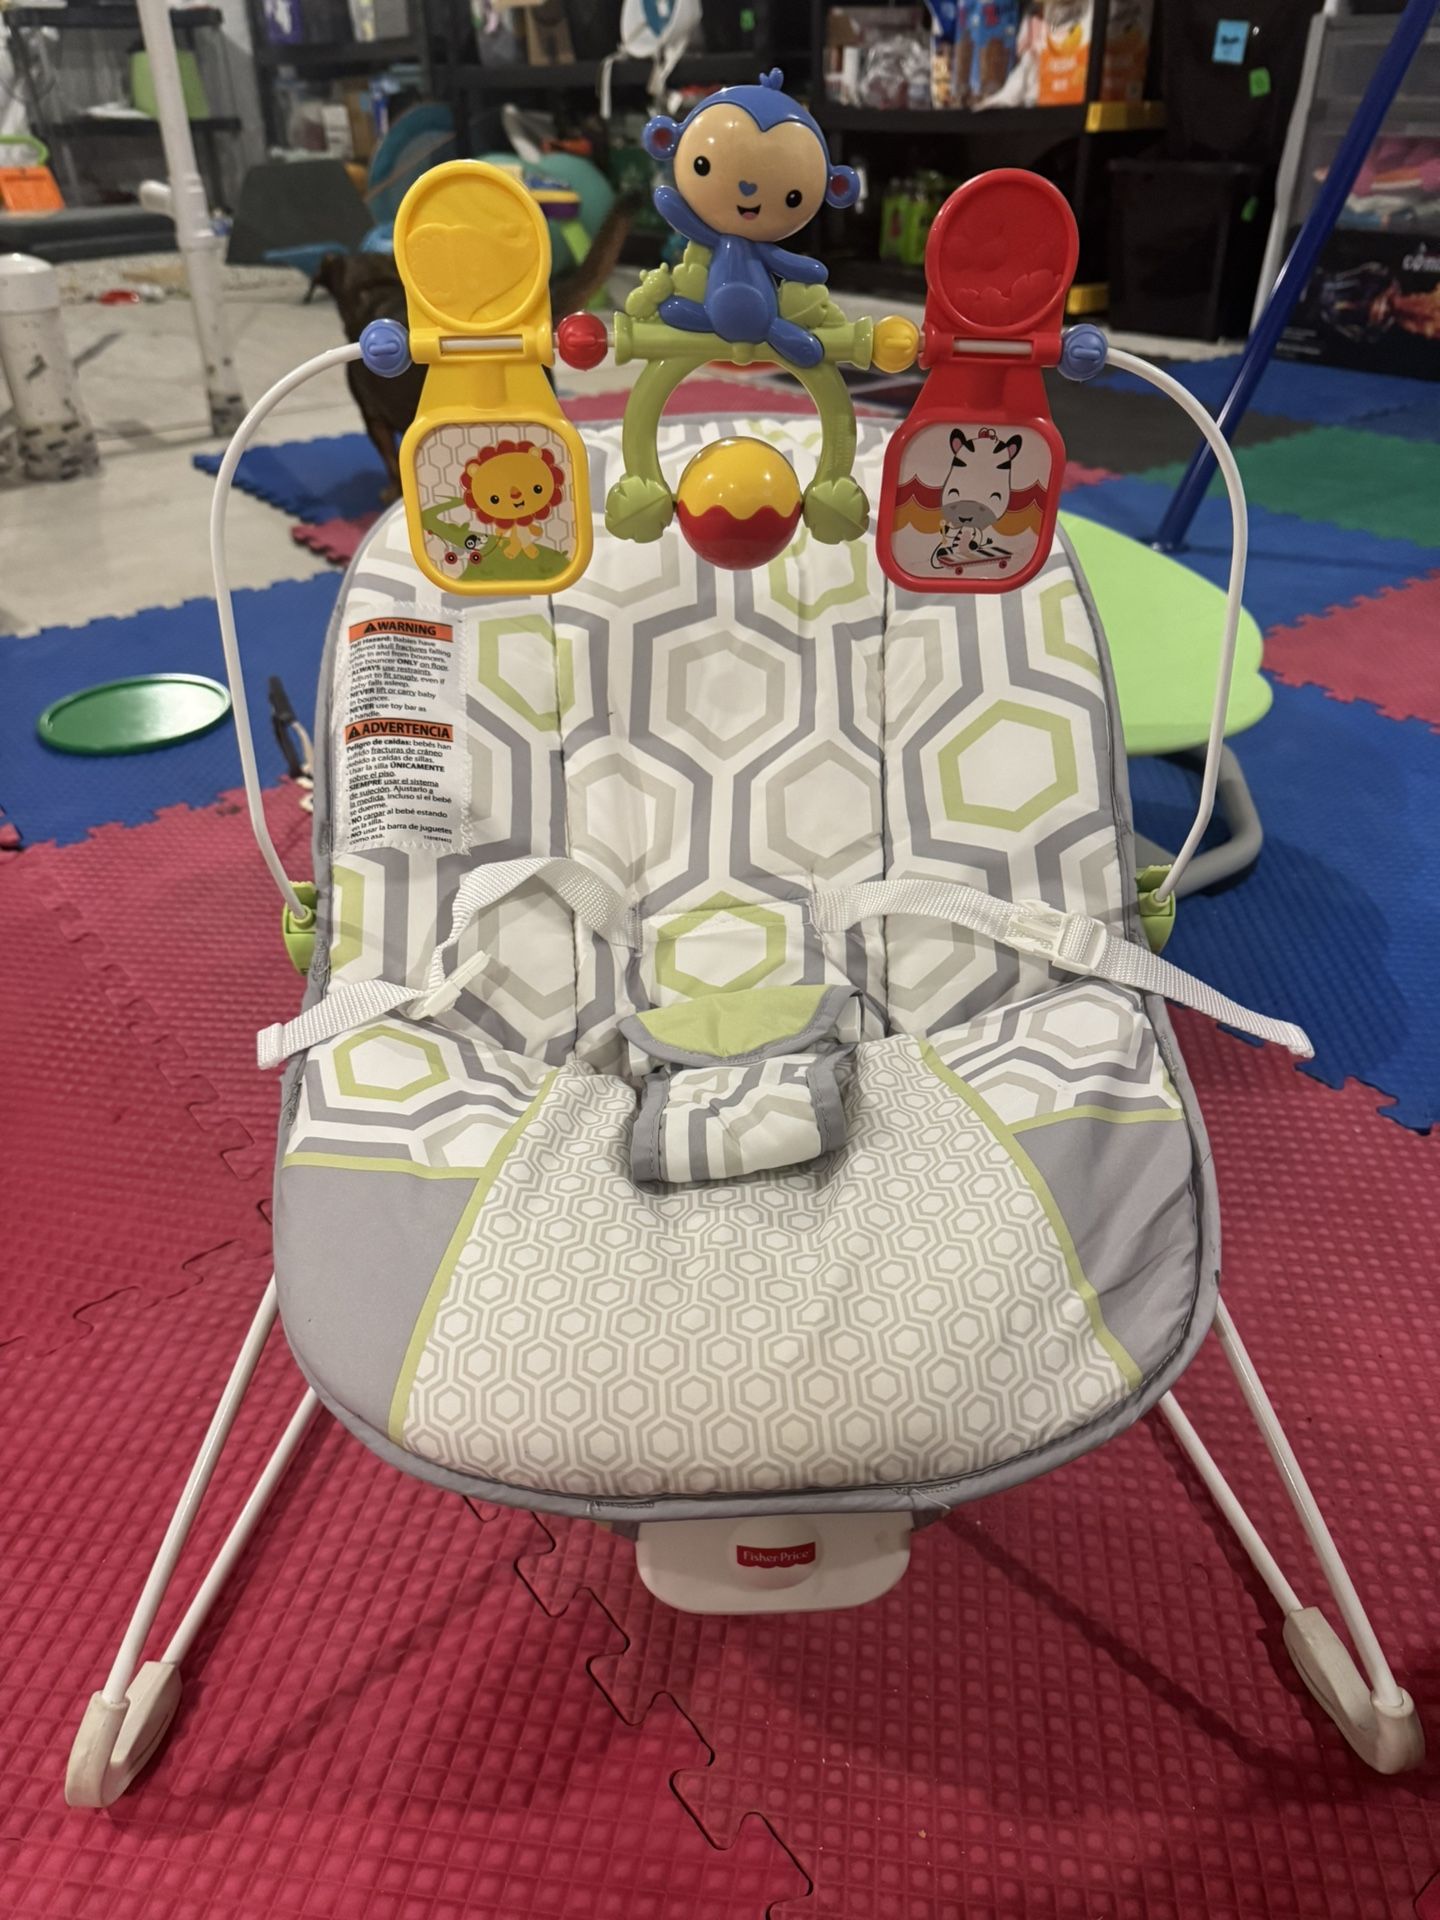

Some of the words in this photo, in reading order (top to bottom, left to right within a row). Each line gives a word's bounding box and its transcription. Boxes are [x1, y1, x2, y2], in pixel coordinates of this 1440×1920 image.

[378, 621, 437, 636] WARNING
[418, 639, 436, 647] have
[395, 643, 427, 654] fractures
[429, 648, 451, 658] falling
[396, 658, 418, 666] ONLY
[352, 665, 380, 676] ALWAYS
[350, 687, 375, 698] NEVER
[418, 690, 436, 700] baby
[350, 703, 374, 713] NEVER
[362, 721, 450, 739] ADVERTENCIA
[346, 741, 371, 753] Peligro
[412, 739, 435, 748] bebés
[437, 742, 452, 750] han
[371, 747, 404, 755] fracturas
[417, 749, 443, 757] cráneo
[390, 761, 445, 772] ÚNICAMENTE
[349, 774, 369, 783] sobre
[349, 780, 381, 791] SIEMPRE
[410, 778, 439, 787] sistema
[393, 785, 428, 793] Ajustarlo
[358, 802, 388, 813] duerme.
[351, 815, 362, 824] NO
[363, 811, 386, 820] cargar
[395, 807, 415, 815] bebé
[416, 809, 448, 818] estando
[350, 830, 362, 839] NO
[363, 827, 377, 835] usar
[419, 824, 452, 834] juguetes
[349, 836, 370, 845] como
